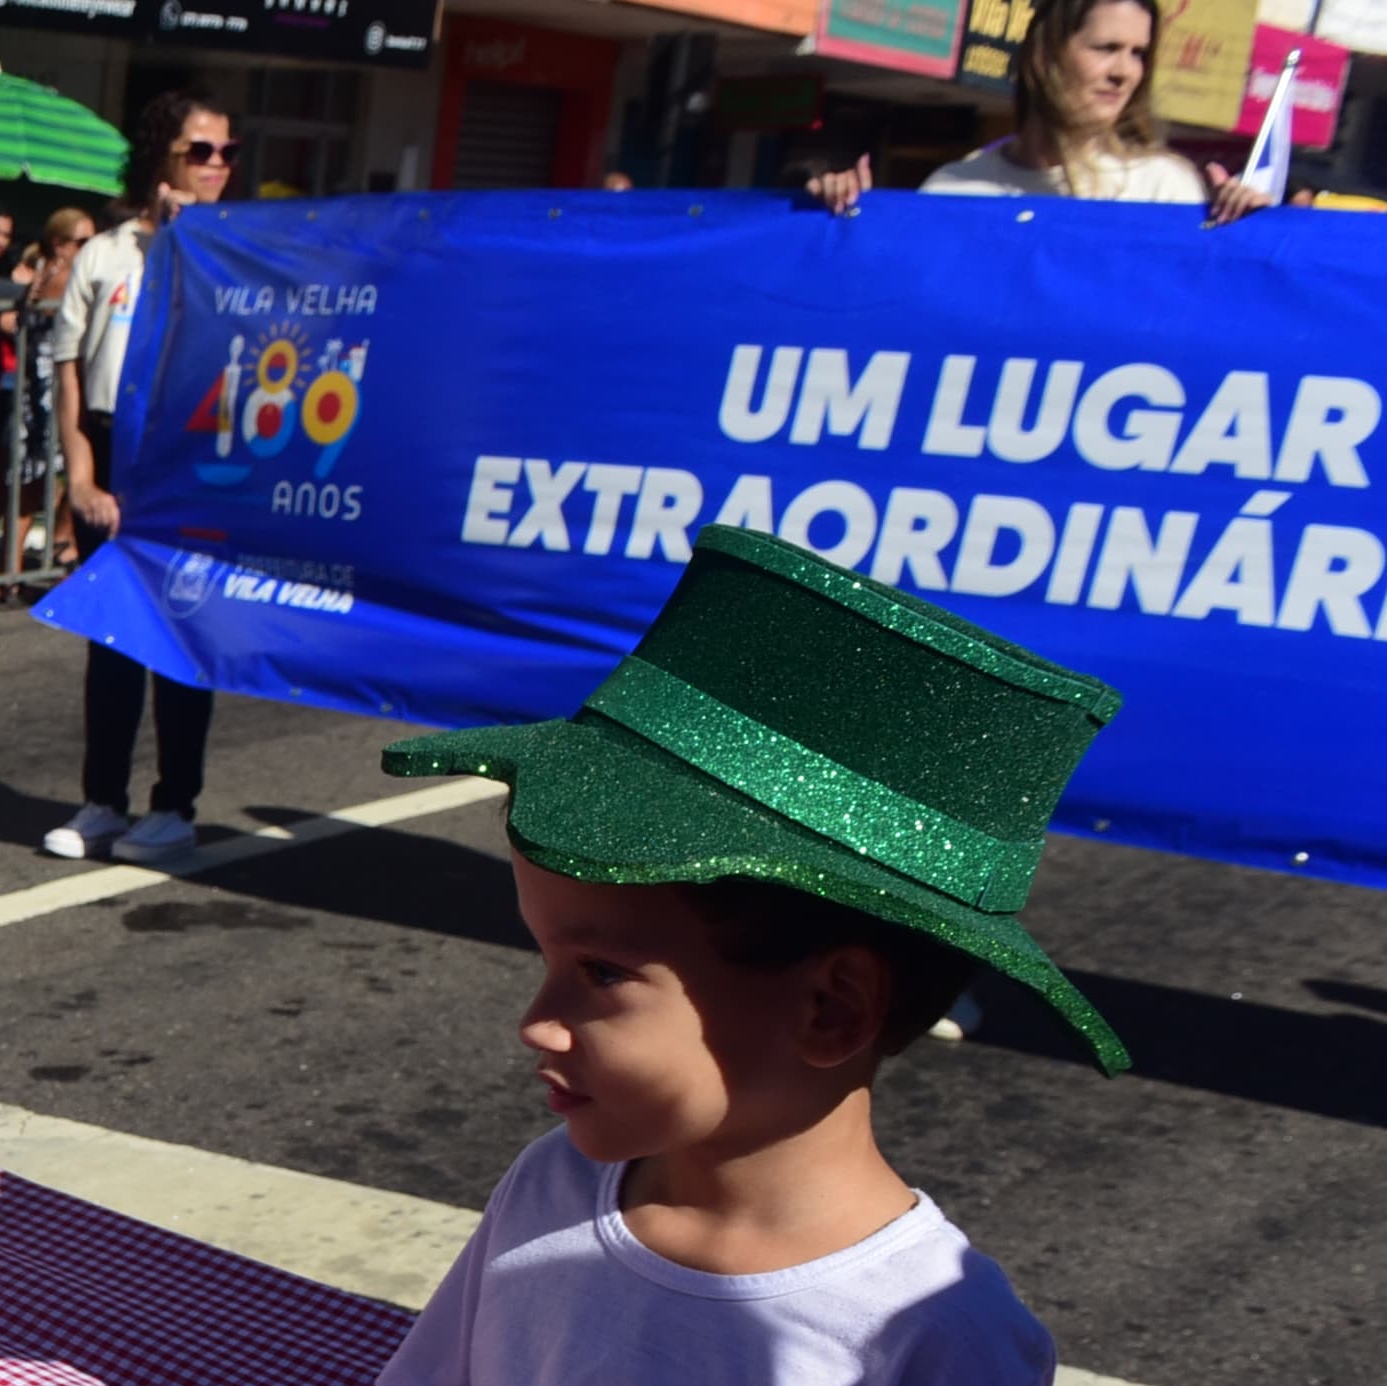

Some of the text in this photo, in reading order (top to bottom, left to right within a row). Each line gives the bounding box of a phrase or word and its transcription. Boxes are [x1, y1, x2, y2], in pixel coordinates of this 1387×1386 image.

[214, 284, 378, 316] VILA VELHA
[718, 344, 1383, 488] UM LUGAR
[271, 480, 363, 520] ANOS
[460, 455, 1387, 643] EXTRAORDINÁR
[223, 573, 355, 614] VILA VELHA
